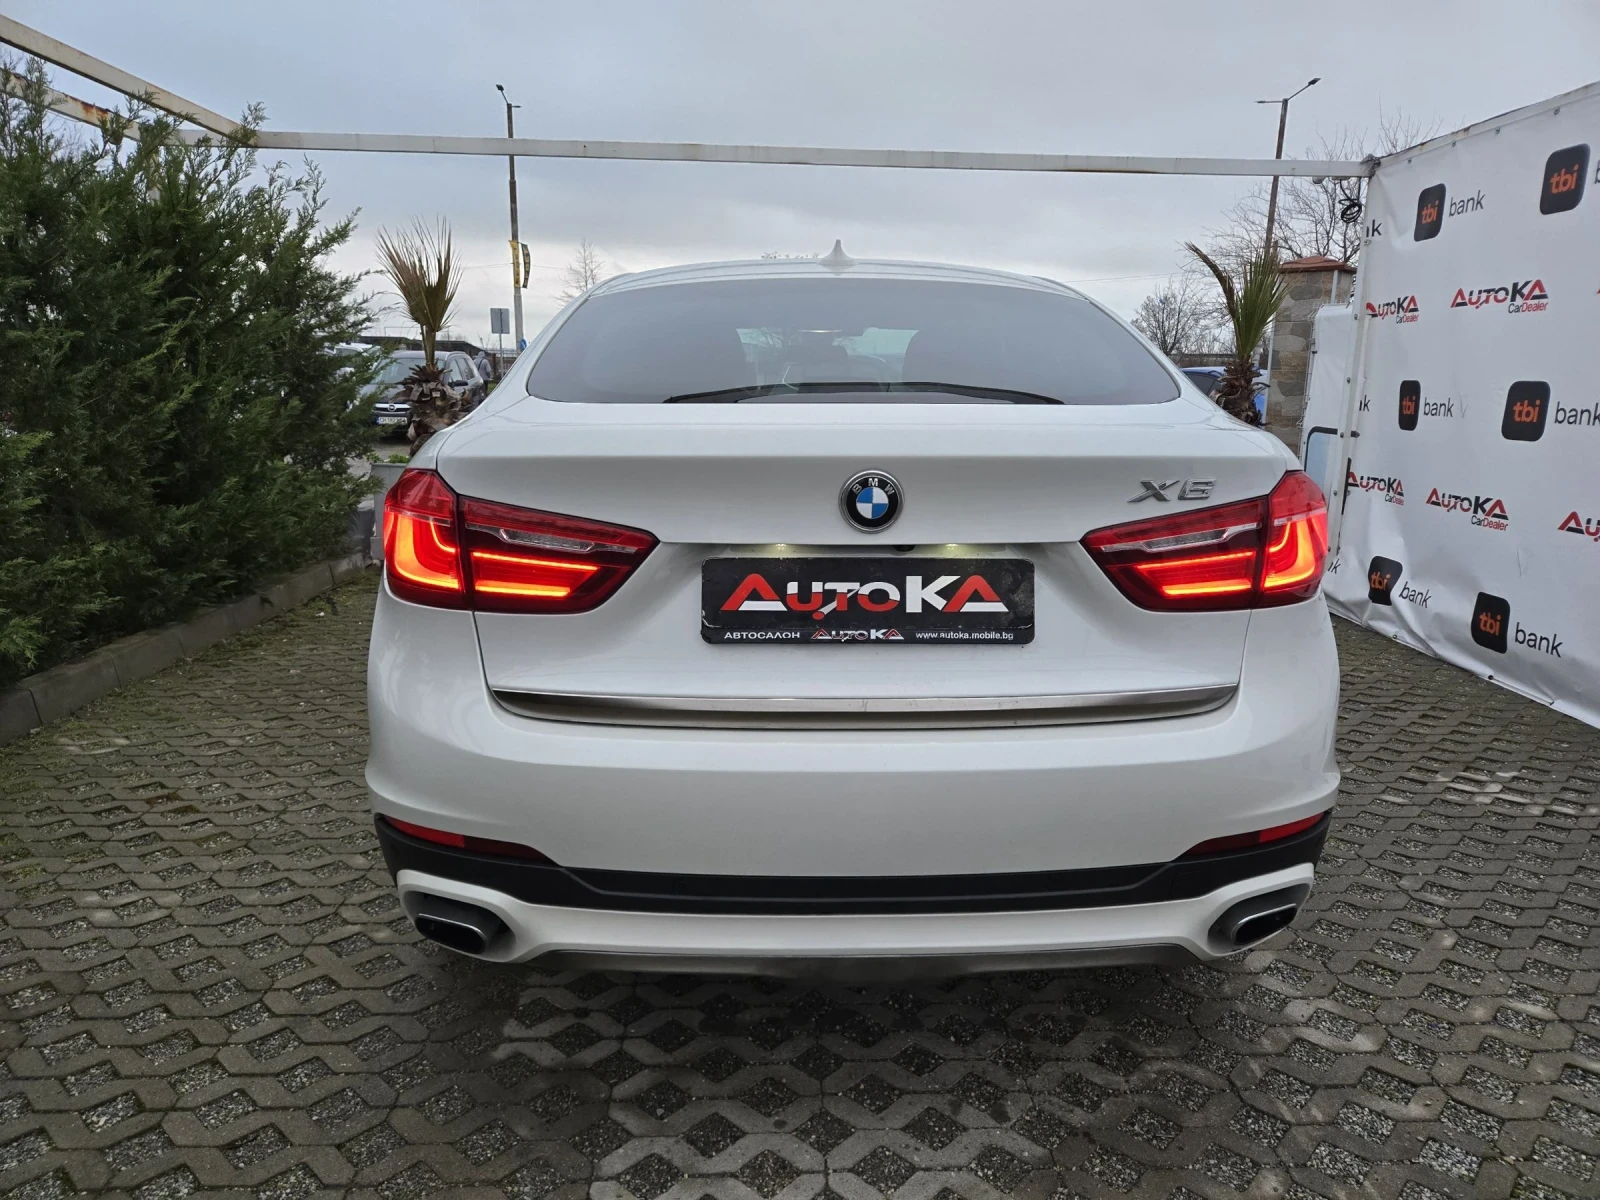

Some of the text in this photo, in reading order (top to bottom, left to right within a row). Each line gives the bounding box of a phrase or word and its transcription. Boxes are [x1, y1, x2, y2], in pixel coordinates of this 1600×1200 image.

[1550, 163, 1579, 194] tbi
[1421, 189, 1486, 224] tbi bank
[1508, 301, 1549, 314] CarDealer
[1402, 396, 1454, 417] tbi bank
[1513, 399, 1600, 426] tbi bank
[851, 478, 895, 495] BMW
[1126, 478, 1217, 503] X6
[1471, 515, 1509, 531] CarDealer
[1370, 571, 1432, 608] tbi bank
[724, 631, 800, 639] АВТОСАЛОН
[915, 631, 1014, 641] www.autoka.mobile.bg
[1479, 612, 1563, 658] tbi bank
